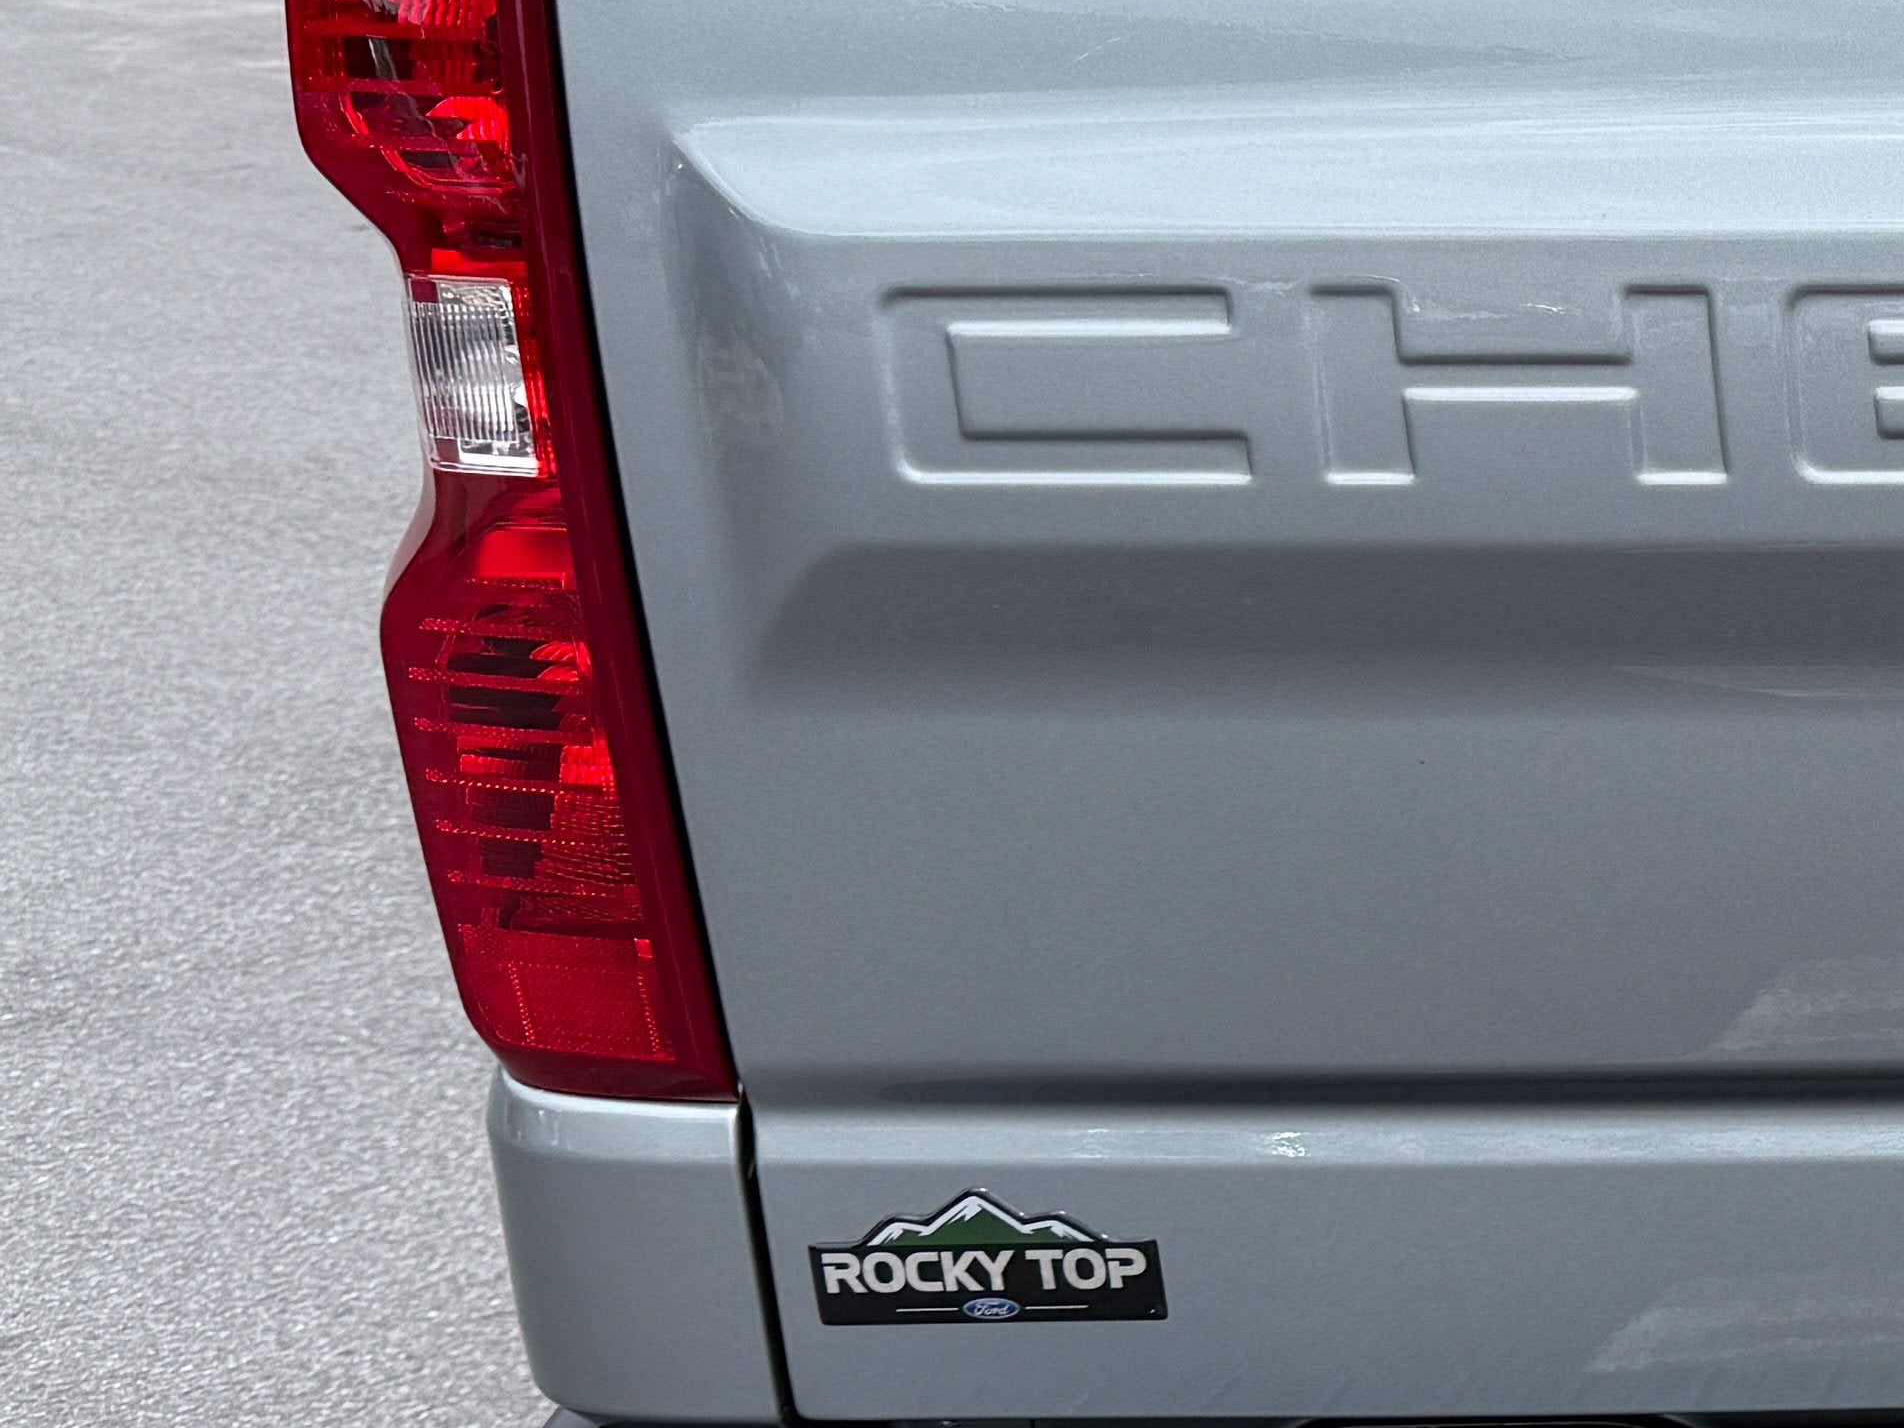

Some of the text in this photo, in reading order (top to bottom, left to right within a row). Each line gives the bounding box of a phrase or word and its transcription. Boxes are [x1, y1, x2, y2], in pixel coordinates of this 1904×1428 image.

[821, 1248, 1147, 1295] ROCKY TOP
[972, 1301, 1011, 1317] Ford
